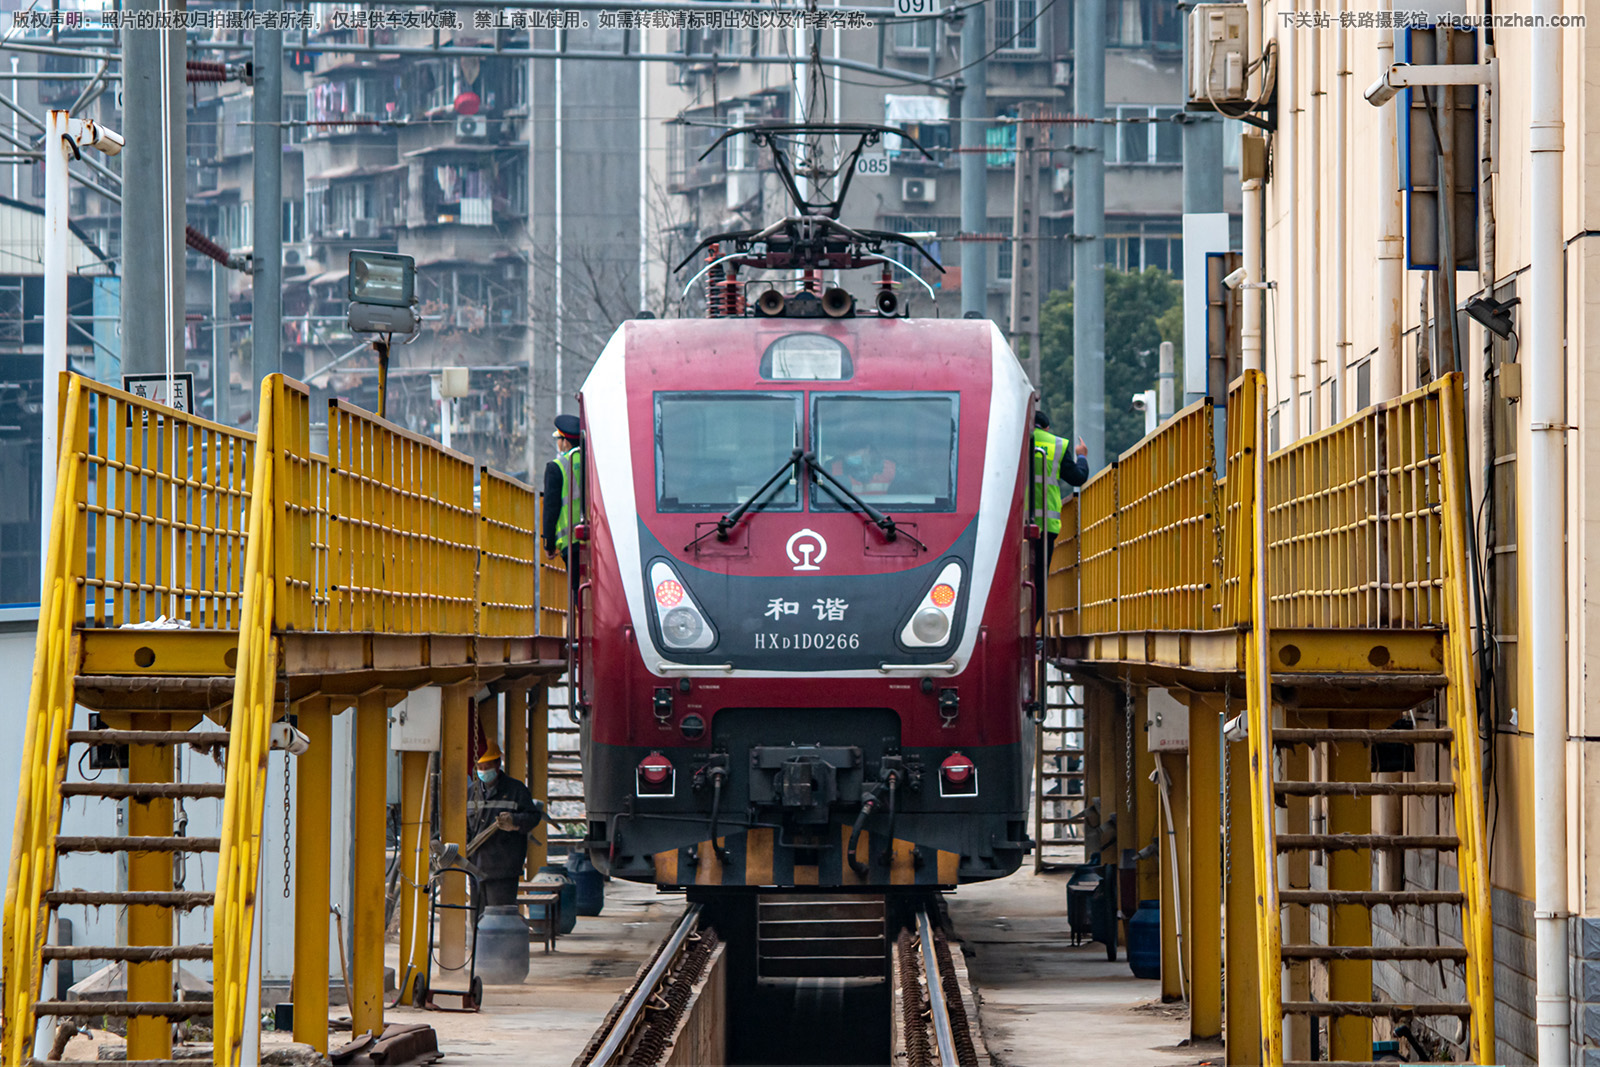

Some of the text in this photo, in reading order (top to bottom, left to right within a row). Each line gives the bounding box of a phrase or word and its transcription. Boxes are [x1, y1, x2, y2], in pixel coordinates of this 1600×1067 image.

[898, 0, 933, 13] 091
[858, 158, 888, 173] 085
[764, 597, 849, 621] 和谐
